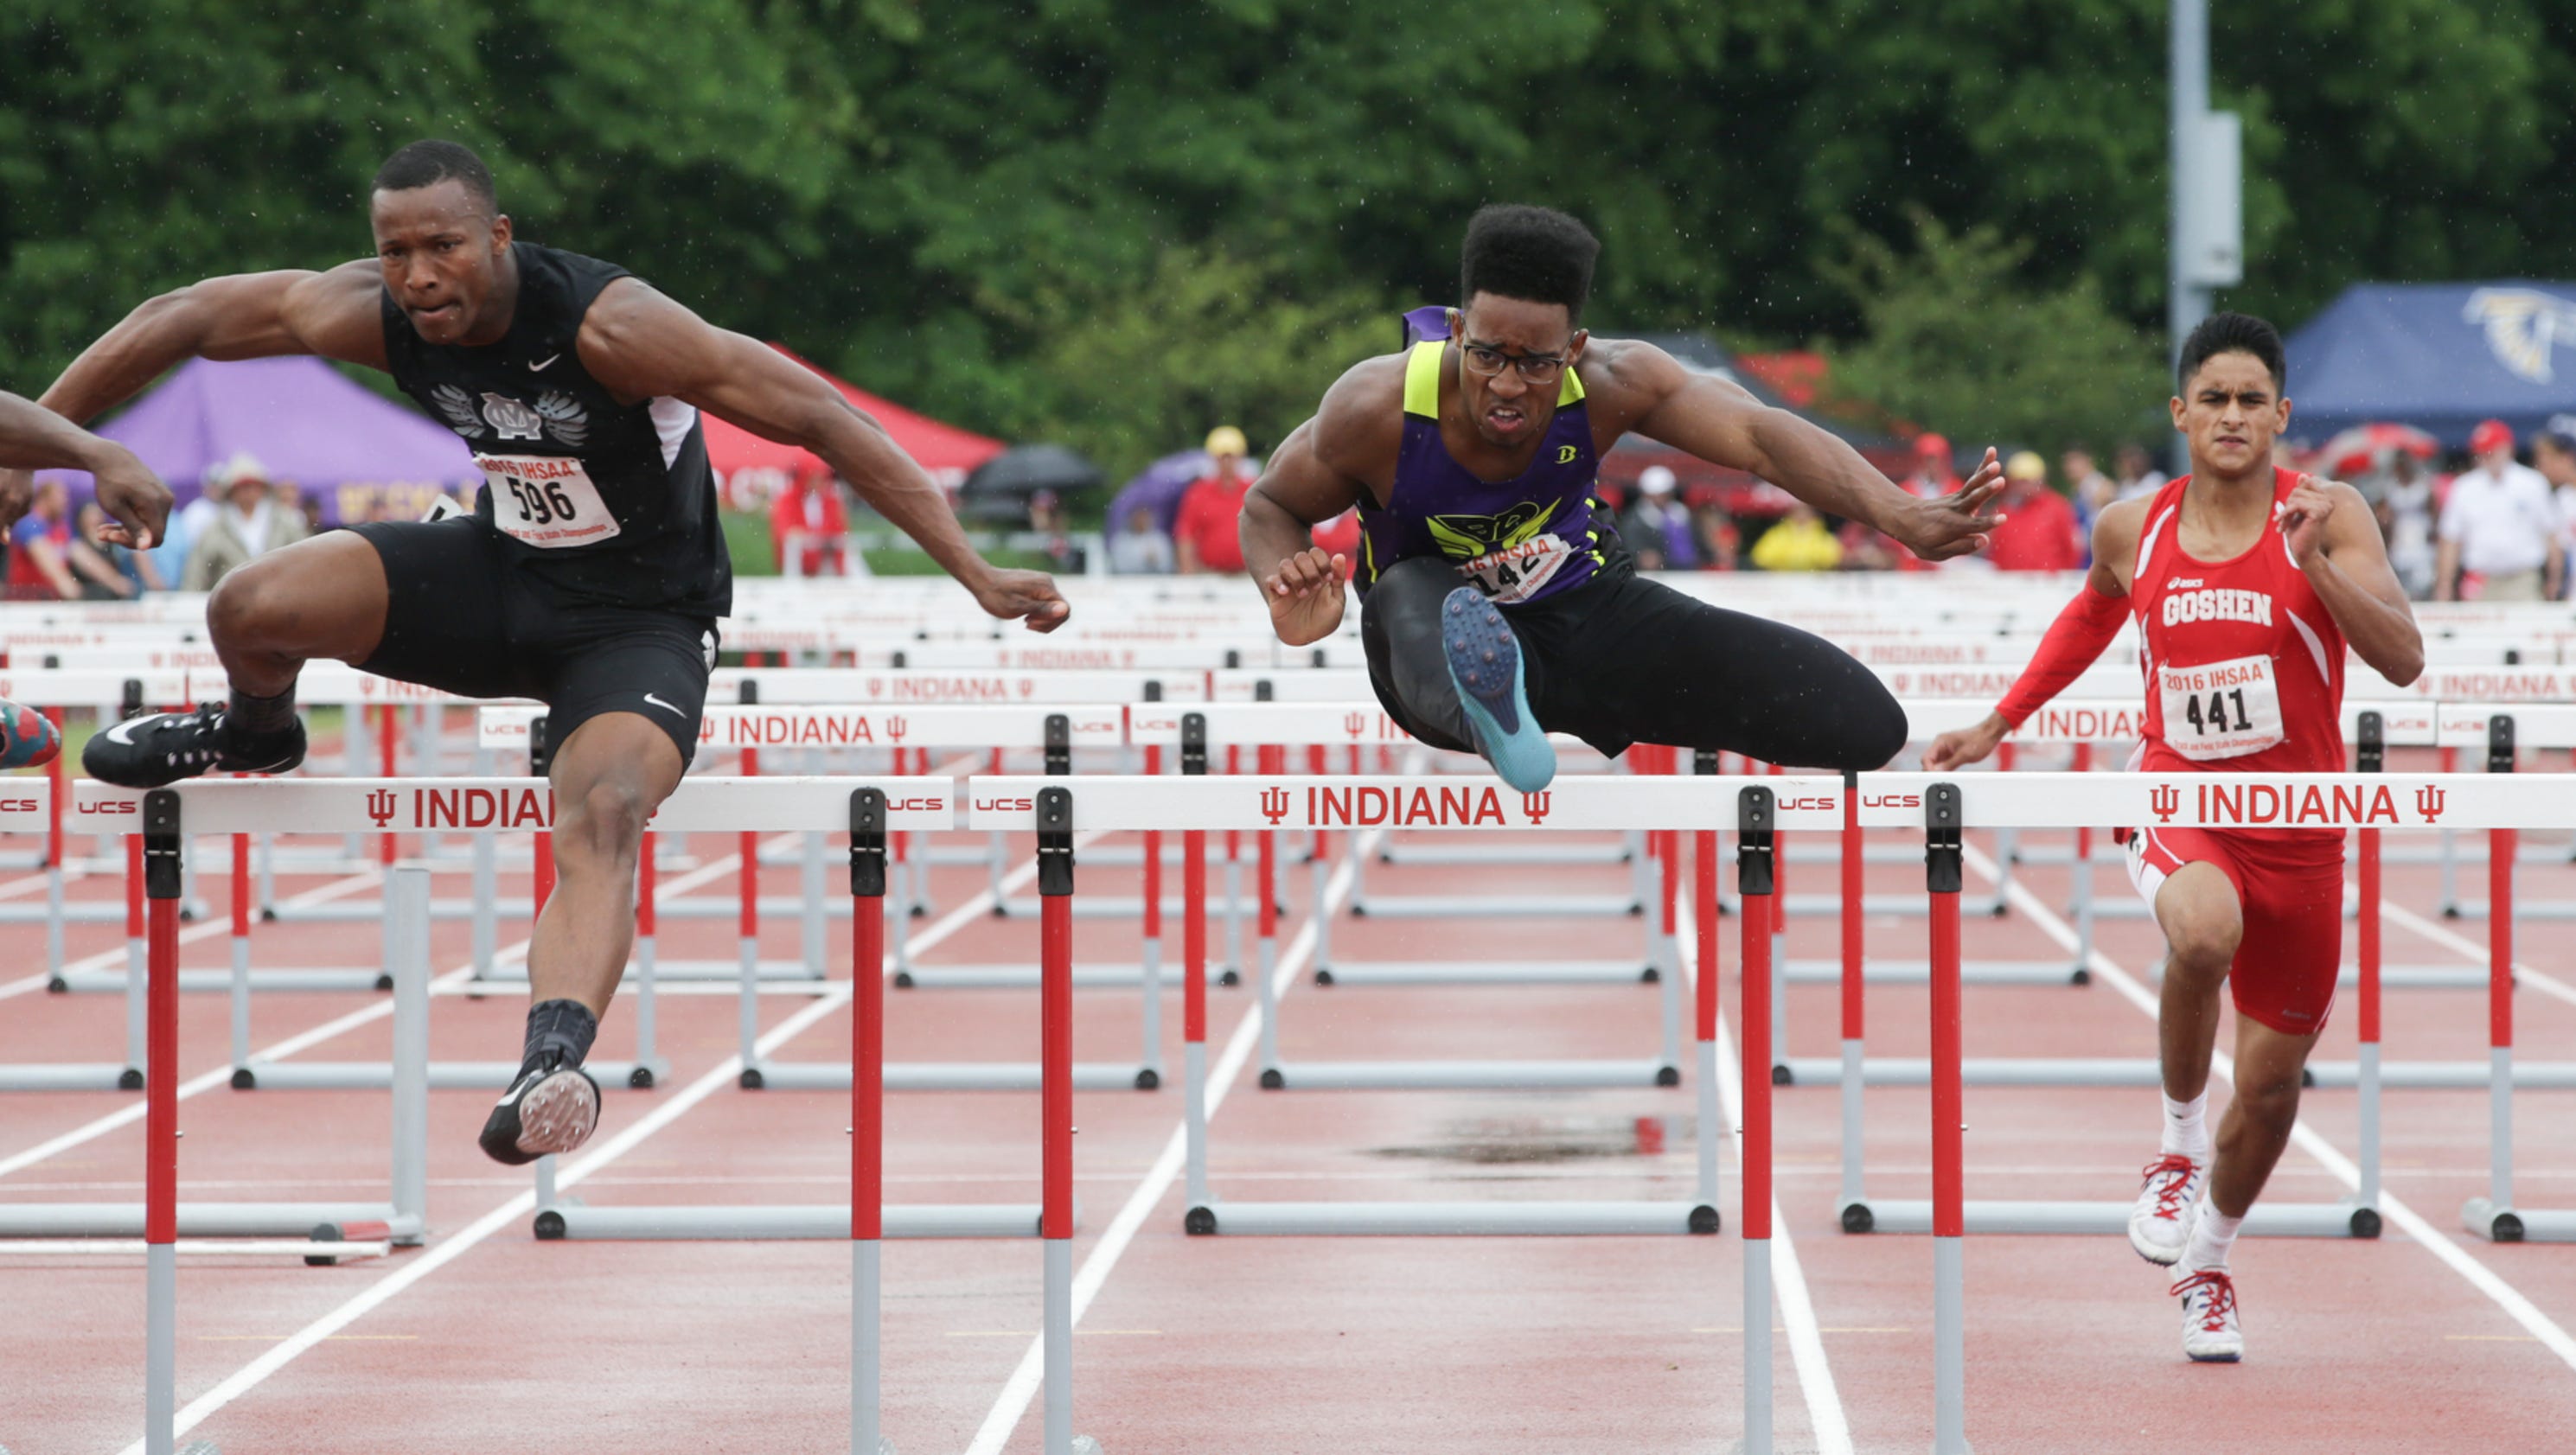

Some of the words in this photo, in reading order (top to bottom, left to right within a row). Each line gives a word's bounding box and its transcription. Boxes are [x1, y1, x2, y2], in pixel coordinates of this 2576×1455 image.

[480, 458, 521, 476] 2016
[521, 461, 576, 479] IHSAA
[506, 475, 576, 525] 596
[2163, 588, 2273, 628] GOSHEN
[2165, 673, 2204, 691] 2016
[2209, 663, 2264, 687] IHSAA
[2441, 674, 2560, 695] INDIANA
[893, 678, 1007, 698] INDIANA
[2187, 688, 2253, 736] 441
[484, 724, 527, 735] UCS
[729, 716, 873, 743] INDIANA
[1072, 722, 1115, 732] UCS
[1135, 719, 1178, 731] UCS
[2038, 710, 2148, 737] INDIA
[0, 799, 38, 812] CS
[79, 801, 137, 814] UCS
[414, 788, 556, 828] INDIA
[885, 798, 943, 812] UCS
[975, 798, 1032, 812] UCS
[1307, 787, 1506, 826] INDIANA
[1778, 797, 1835, 811] UCS
[1863, 795, 1921, 808] UCS
[2198, 784, 2400, 824] INDIANA
